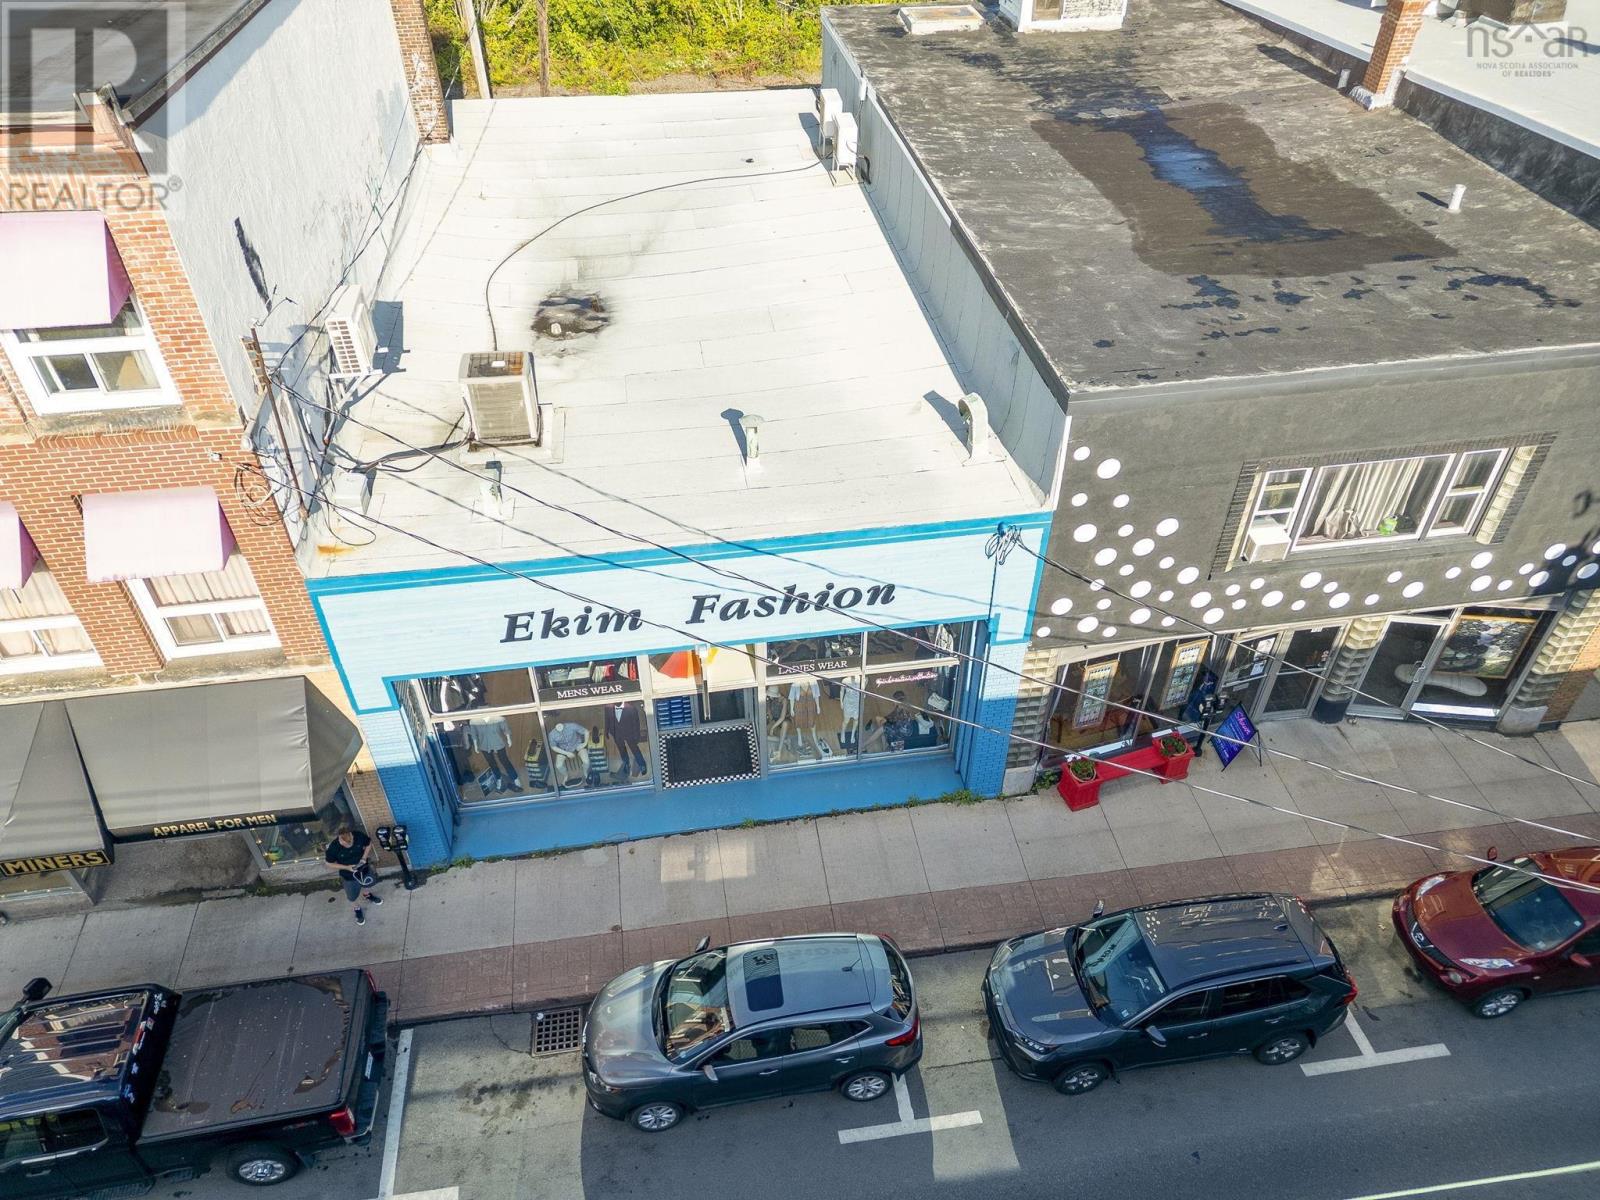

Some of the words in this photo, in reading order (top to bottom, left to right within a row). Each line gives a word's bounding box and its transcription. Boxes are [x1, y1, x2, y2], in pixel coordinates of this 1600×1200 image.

[500, 605, 643, 643] Ekim
[684, 582, 896, 624] Fashion
[817, 660, 848, 671] WEAR
[556, 687, 589, 699] MENS
[590, 684, 624, 696] WEAR
[153, 821, 215, 837] APPAREL
[214, 816, 246, 830] FOR
[246, 813, 278, 827] MEN
[4, 852, 104, 874] MINERS
